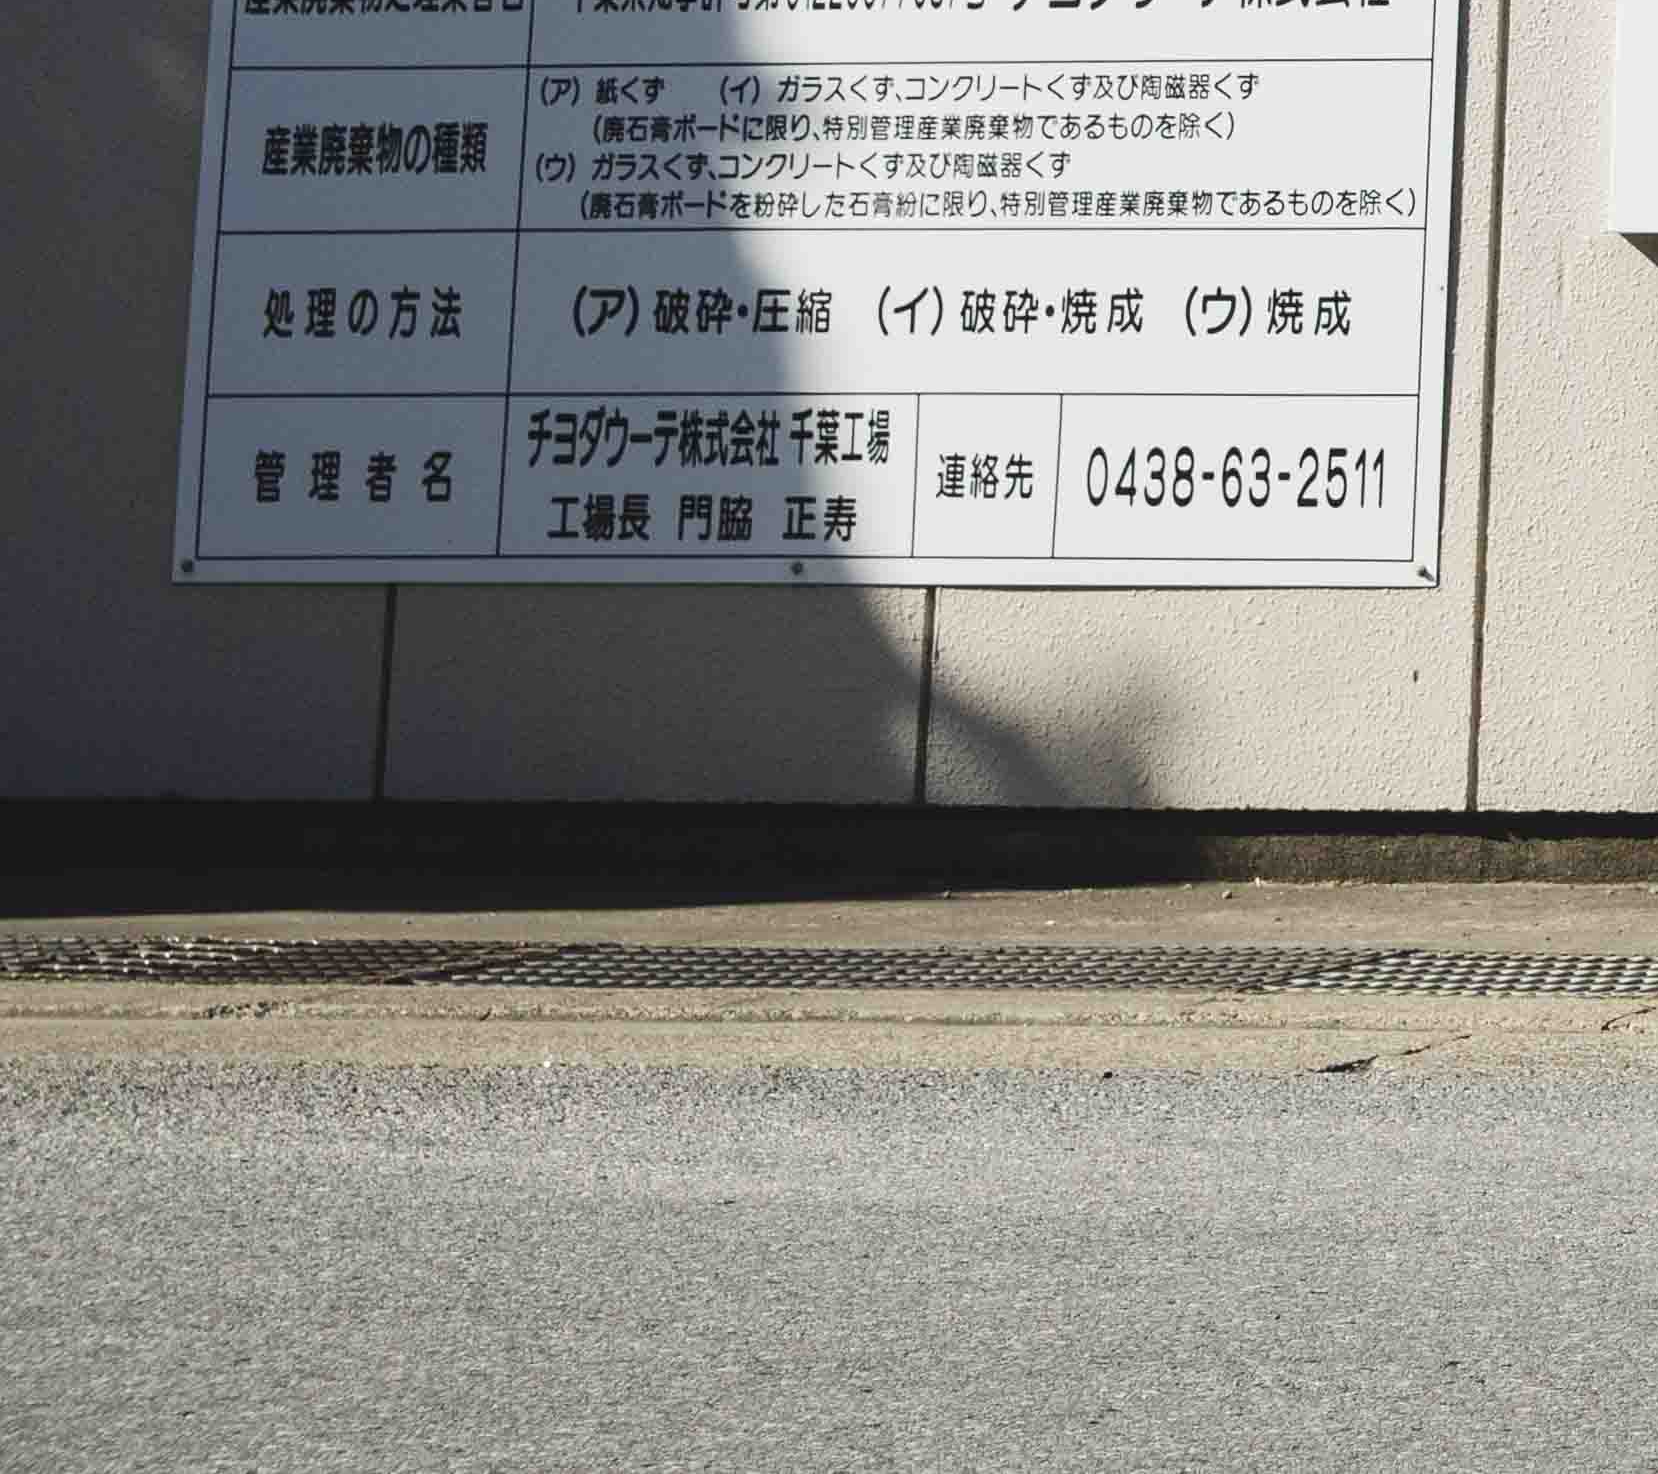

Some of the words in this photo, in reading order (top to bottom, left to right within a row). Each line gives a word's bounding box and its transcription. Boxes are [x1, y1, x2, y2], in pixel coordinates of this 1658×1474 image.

[261, 120, 489, 177] 産業廃棄物の種類
[263, 284, 463, 341] 処理の方法
[527, 404, 782, 469] チヨダウーテ株式会社
[788, 407, 891, 467] 千葉工場
[253, 448, 453, 504] 管理者名
[935, 452, 1034, 500] 連絡先
[1086, 445, 1385, 509] 0438-63-2511
[546, 492, 652, 543] 工場長
[677, 493, 753, 543] 門脇
[781, 494, 857, 543] 正寿
